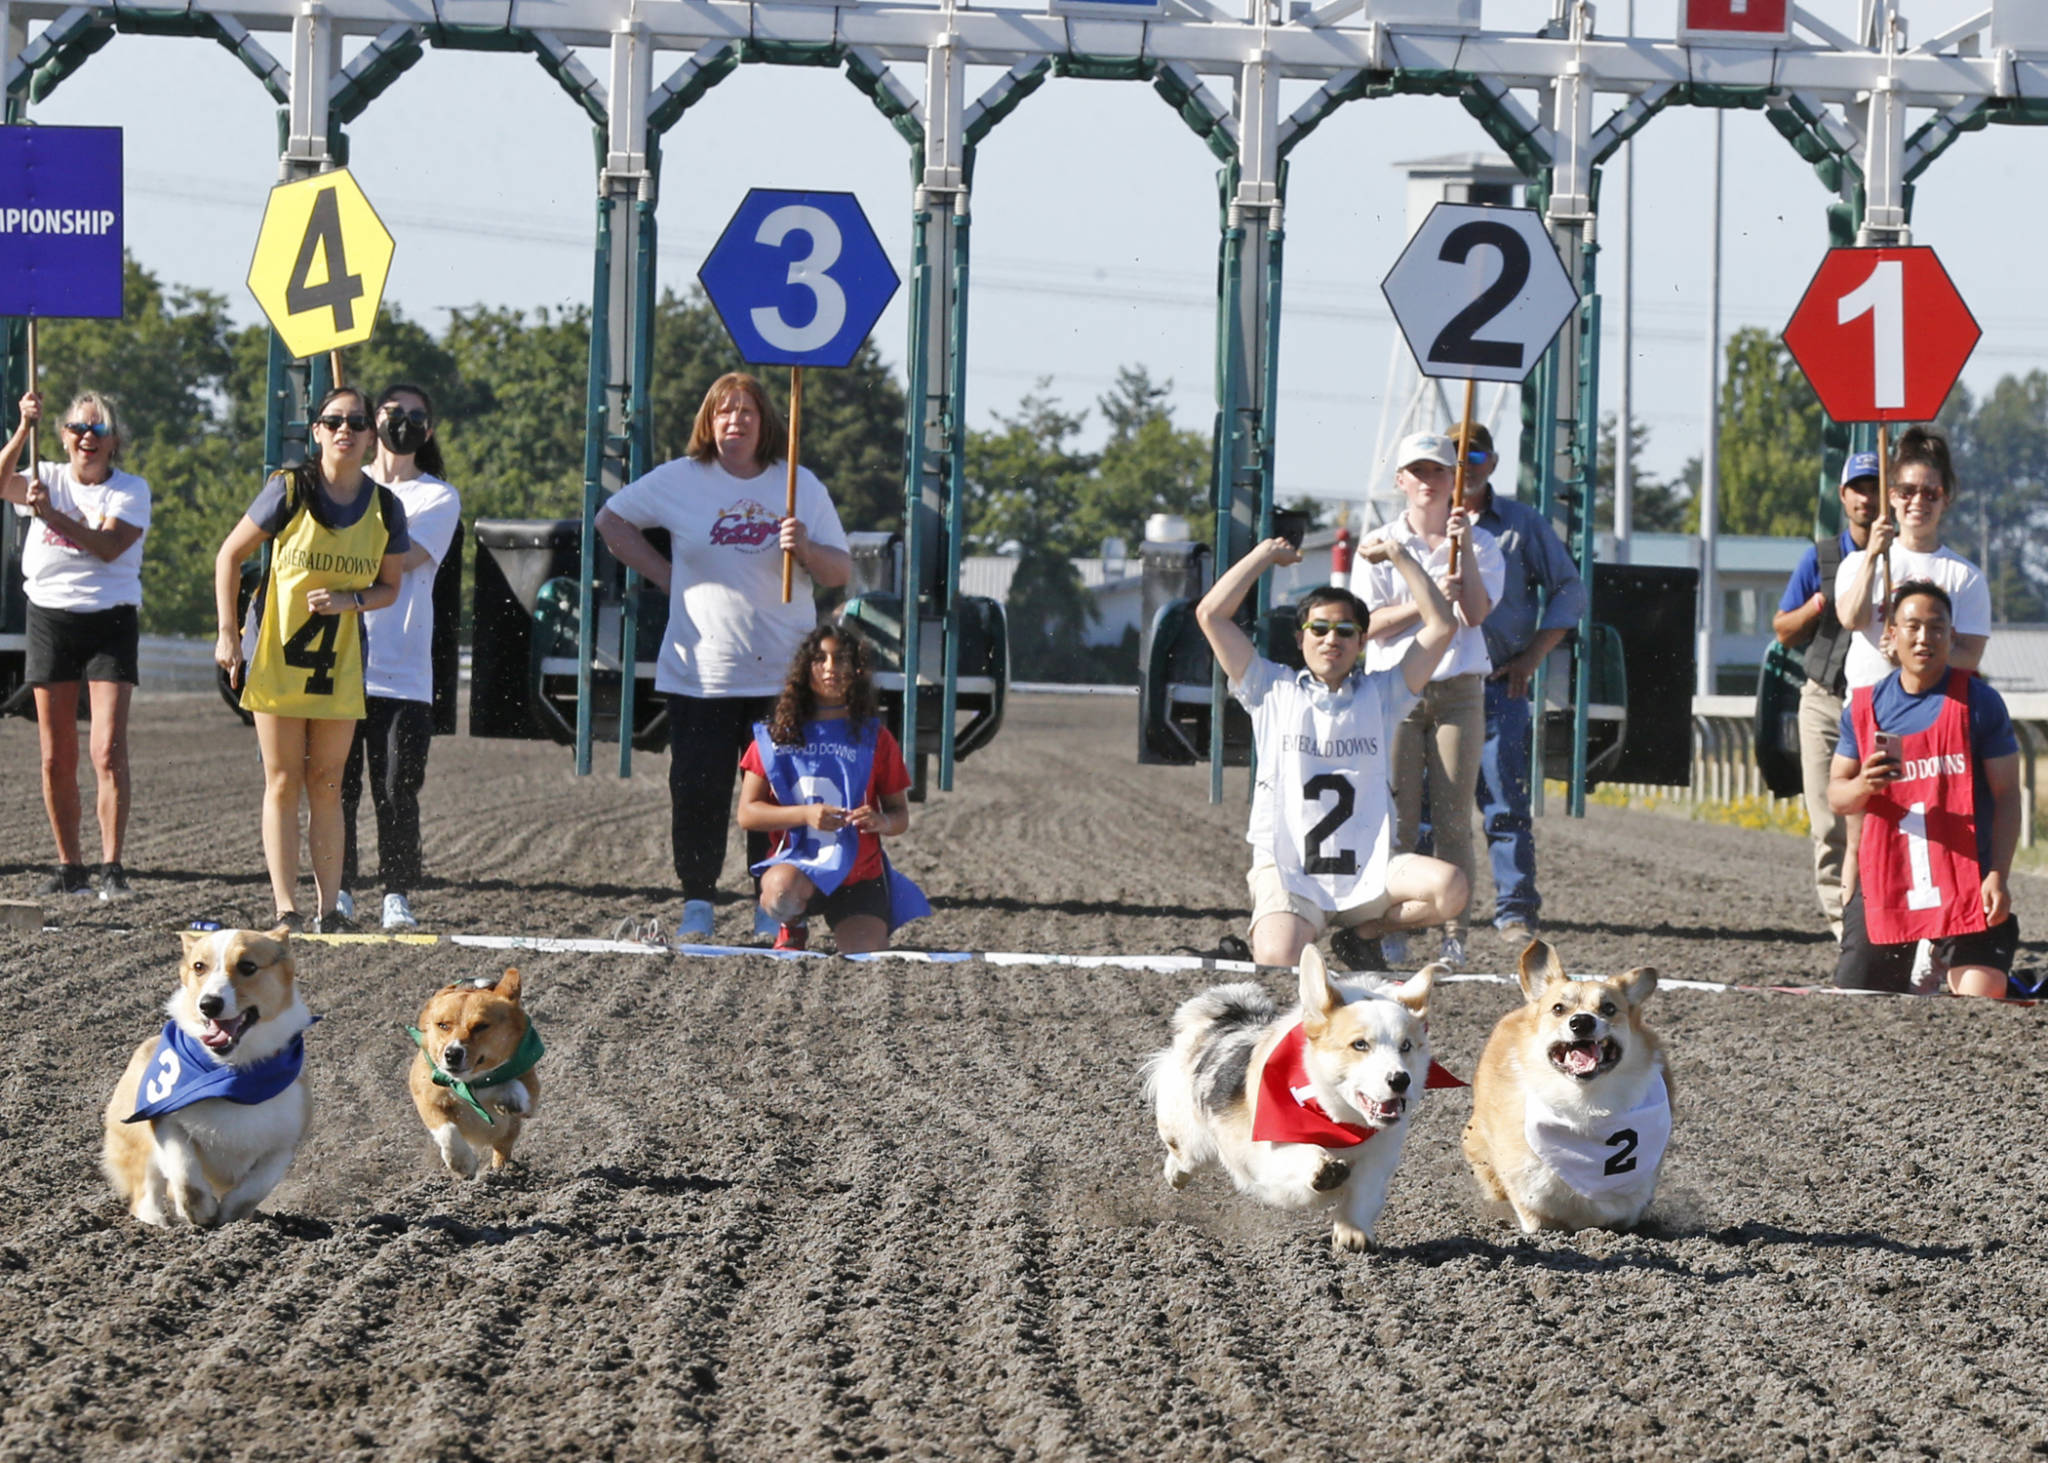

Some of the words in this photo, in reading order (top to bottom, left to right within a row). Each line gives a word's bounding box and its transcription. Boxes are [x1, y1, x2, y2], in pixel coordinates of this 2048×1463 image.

[286, 186, 364, 333] 4
[750, 205, 847, 352] 3
[1427, 221, 1531, 368] 2
[1838, 260, 1905, 408] 1
[282, 547, 333, 572] MERALD
[283, 611, 340, 695] 4
[1336, 737, 1378, 758] DOWNS
[1303, 774, 1356, 875] 2
[1898, 802, 1942, 911] 1
[147, 1048, 181, 1104] 3
[1604, 1128, 1638, 1176] 2
